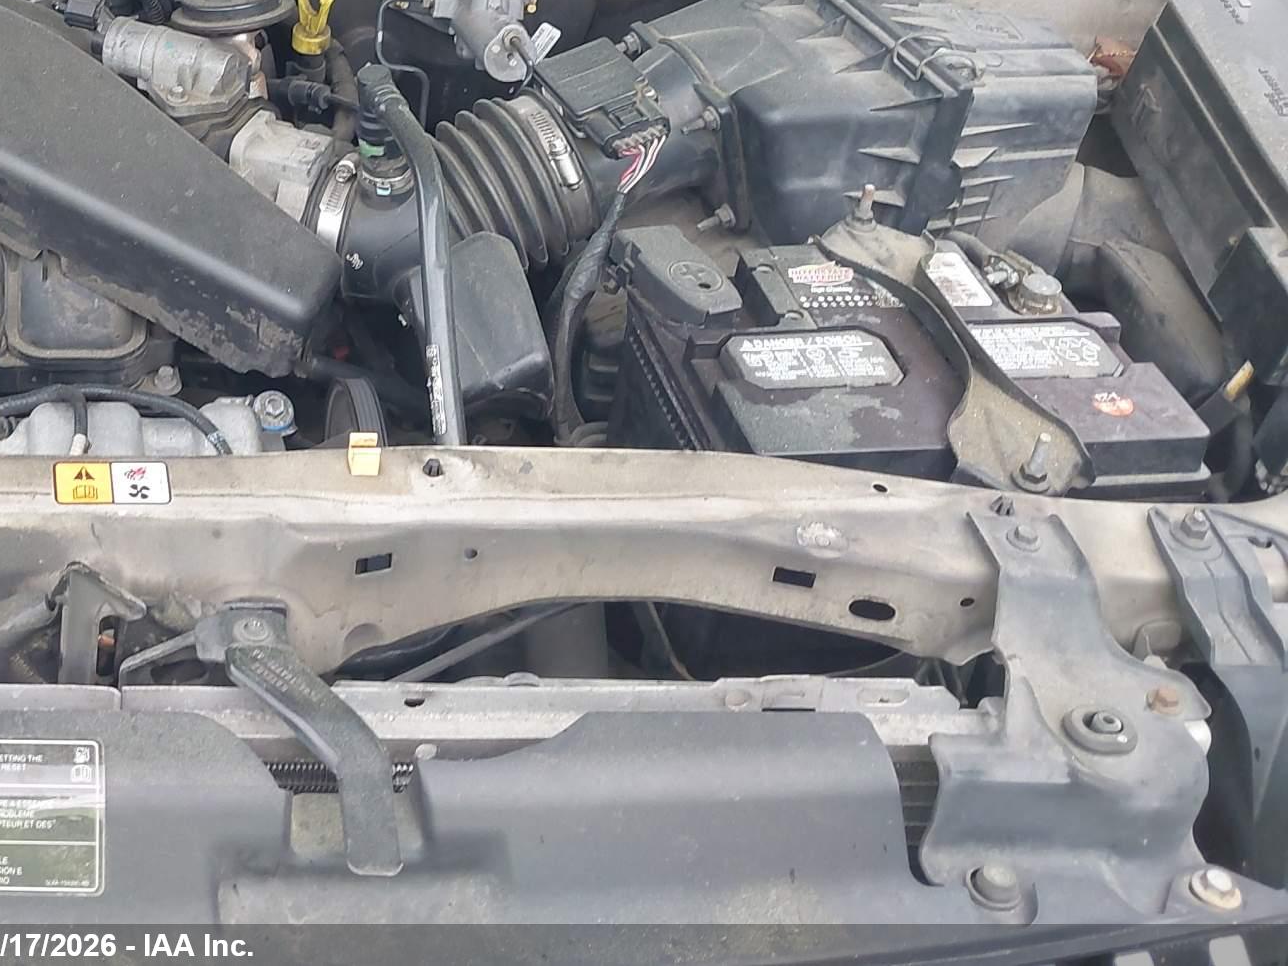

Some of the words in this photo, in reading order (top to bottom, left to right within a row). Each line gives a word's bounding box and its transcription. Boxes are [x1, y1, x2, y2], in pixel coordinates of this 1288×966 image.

[753, 338, 804, 349] DANGER
[814, 335, 862, 348] POISON
[28, 754, 43, 762] THE
